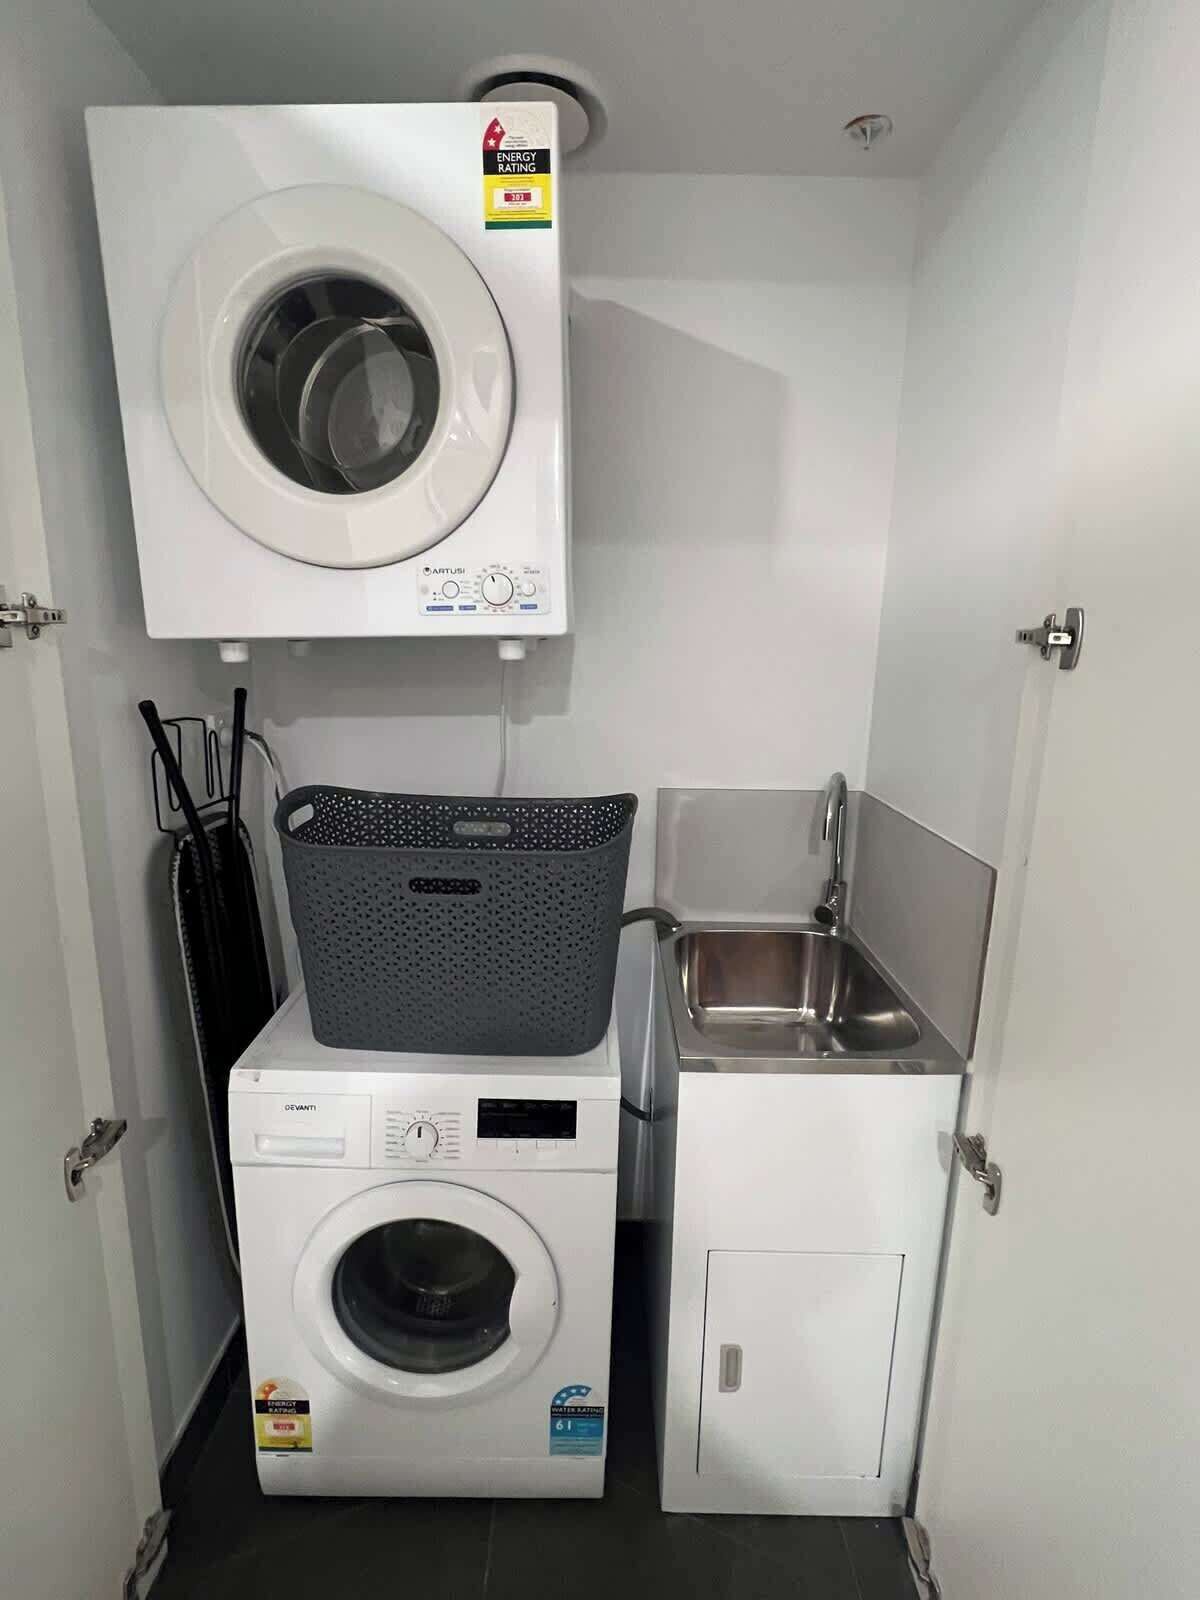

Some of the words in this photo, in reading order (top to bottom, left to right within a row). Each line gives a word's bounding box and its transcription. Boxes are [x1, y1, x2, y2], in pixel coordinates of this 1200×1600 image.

[496, 151, 537, 162] ENERGY
[498, 162, 537, 173] RATING
[432, 567, 466, 575] ARTUSI
